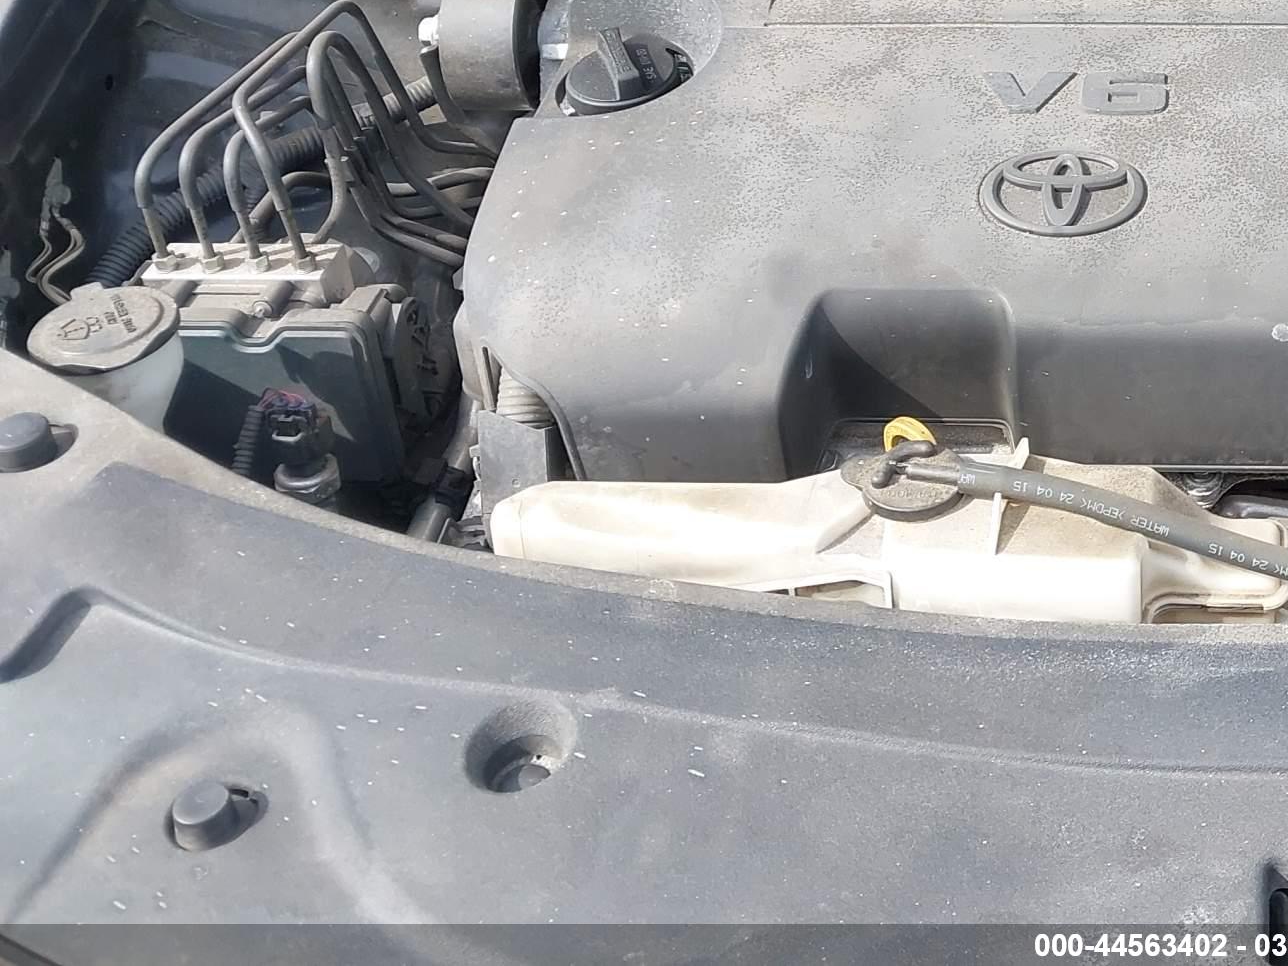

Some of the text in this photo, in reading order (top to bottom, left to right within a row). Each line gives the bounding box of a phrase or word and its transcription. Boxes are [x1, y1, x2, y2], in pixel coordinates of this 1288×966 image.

[984, 71, 1169, 115] V6
[1013, 480, 1028, 493] 15
[1036, 486, 1053, 498] 04
[1059, 492, 1074, 504] 24
[1130, 515, 1170, 538] WATER
[1208, 543, 1223, 556] 15
[1230, 550, 1246, 563] 04
[1252, 557, 1269, 570] 24
